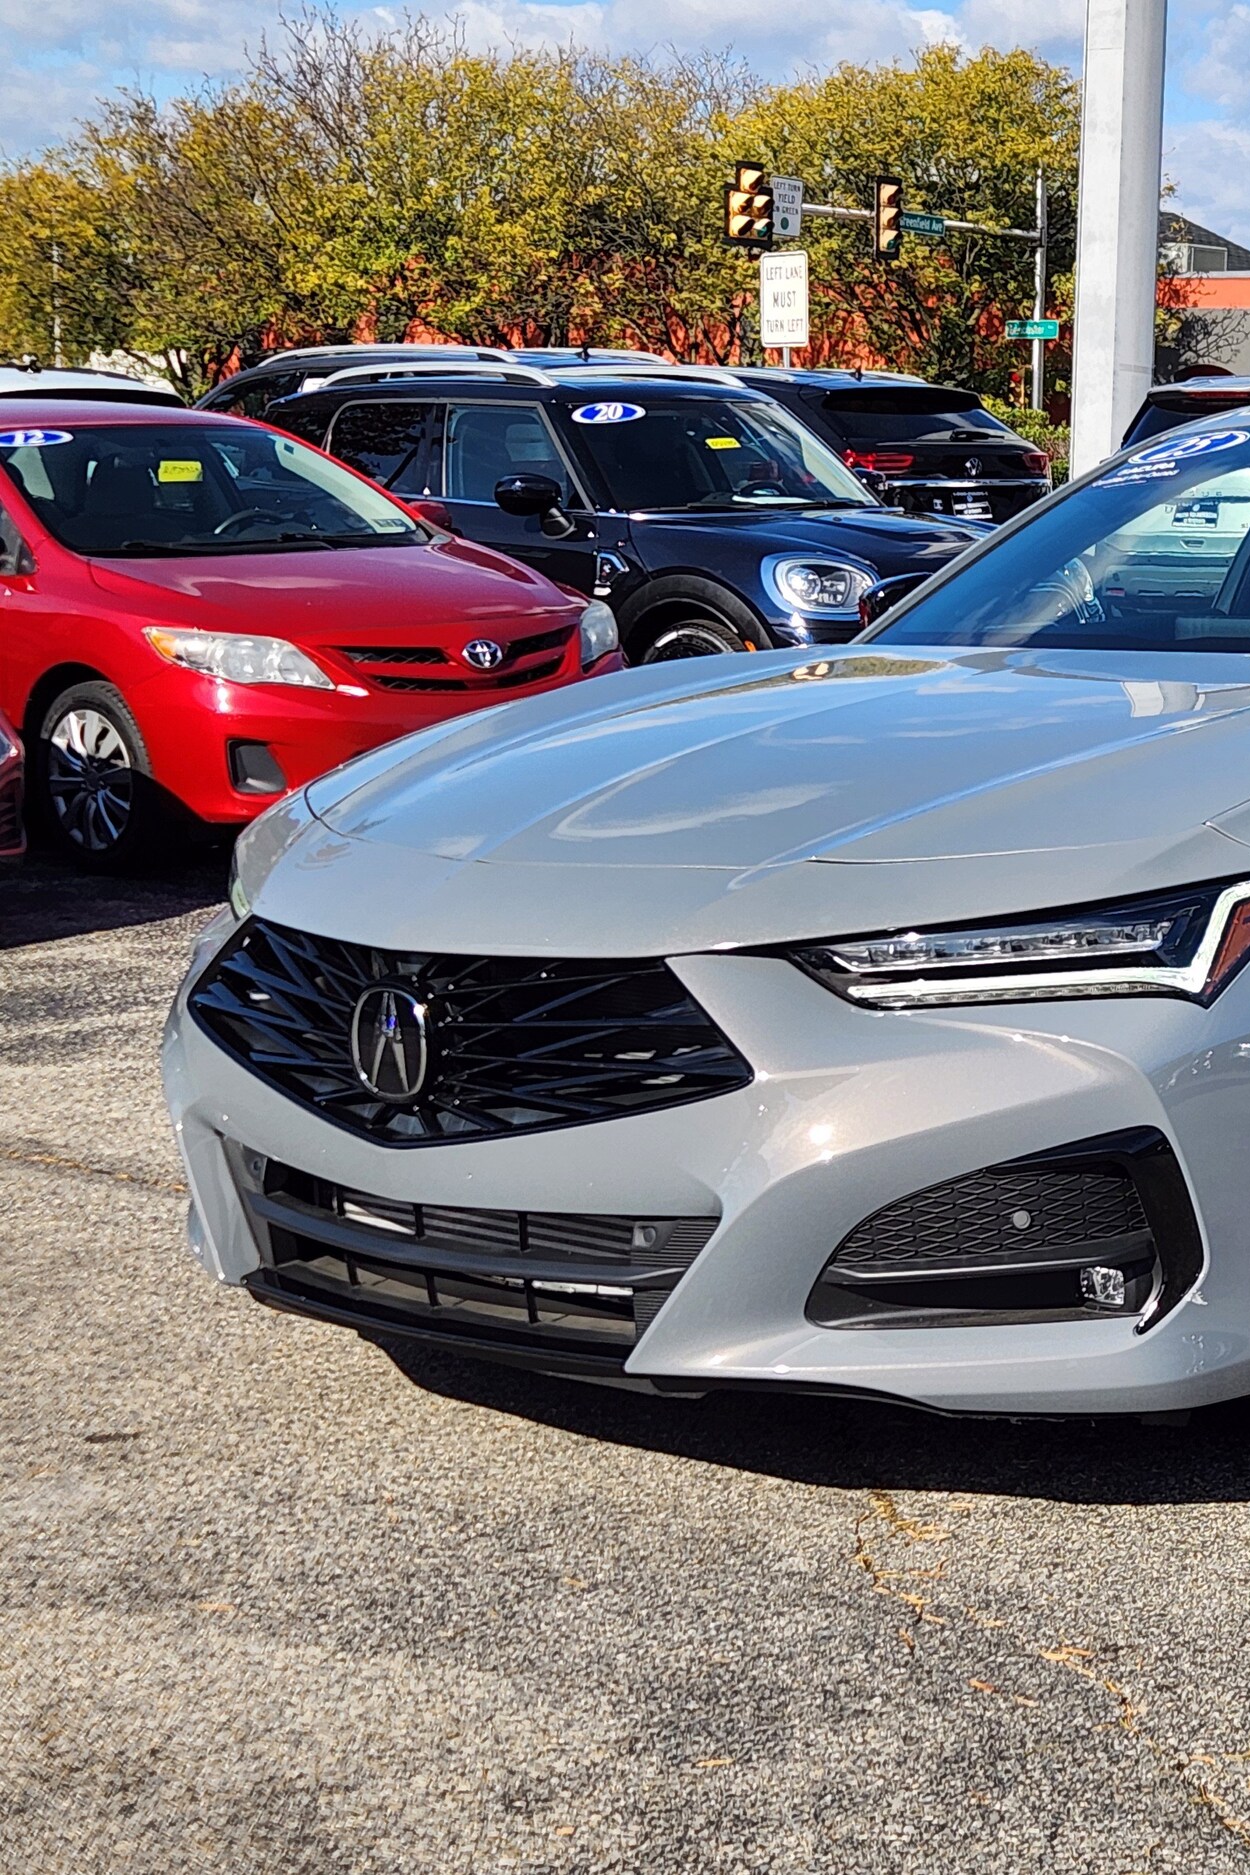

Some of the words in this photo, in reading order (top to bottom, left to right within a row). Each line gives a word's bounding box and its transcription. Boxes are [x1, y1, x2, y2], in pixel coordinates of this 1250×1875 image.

[774, 181, 786, 191] LEFT
[778, 193, 796, 204] YIELD
[931, 219, 943, 232] Ave
[766, 266, 782, 281] LEFT
[785, 265, 803, 280] LANE
[773, 290, 796, 308] MUST
[766, 319, 785, 333] TURN
[787, 318, 803, 333] LEFT
[593, 404, 624, 421] 20
[14, 429, 47, 445] 12
